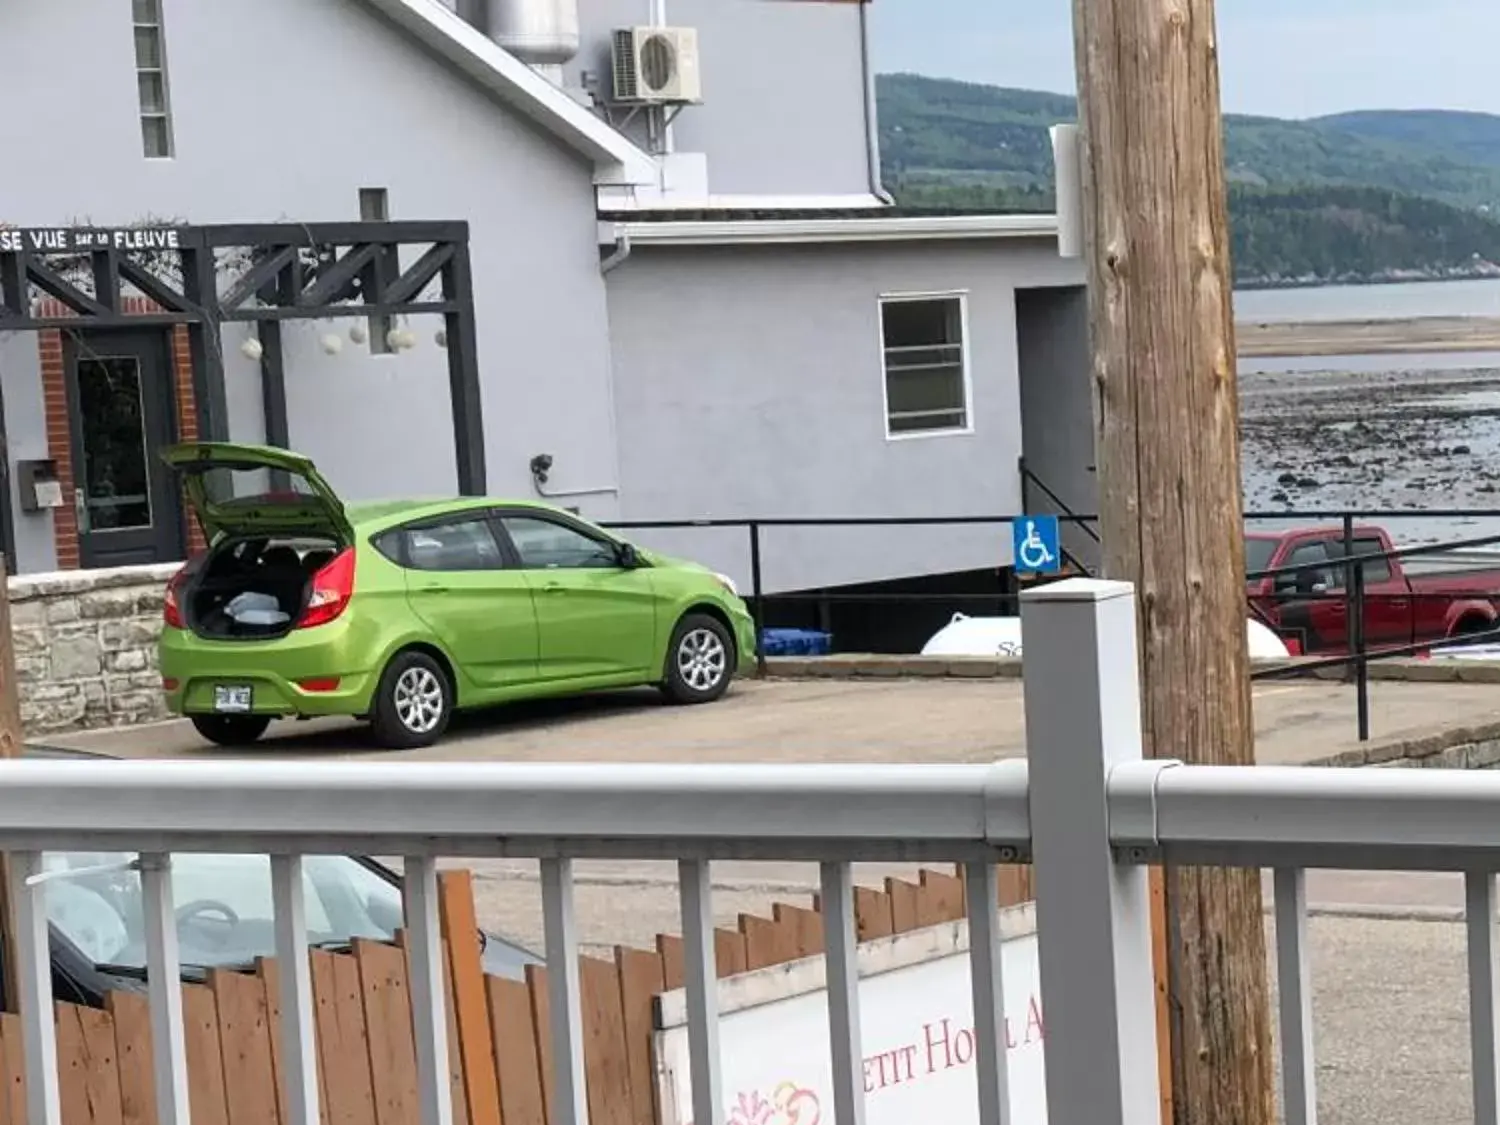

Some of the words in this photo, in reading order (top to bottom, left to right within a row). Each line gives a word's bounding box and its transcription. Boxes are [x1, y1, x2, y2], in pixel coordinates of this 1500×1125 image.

[30, 231, 66, 248] VUE
[114, 231, 179, 248] FLEUVE
[862, 1045, 917, 1093] ETIT
